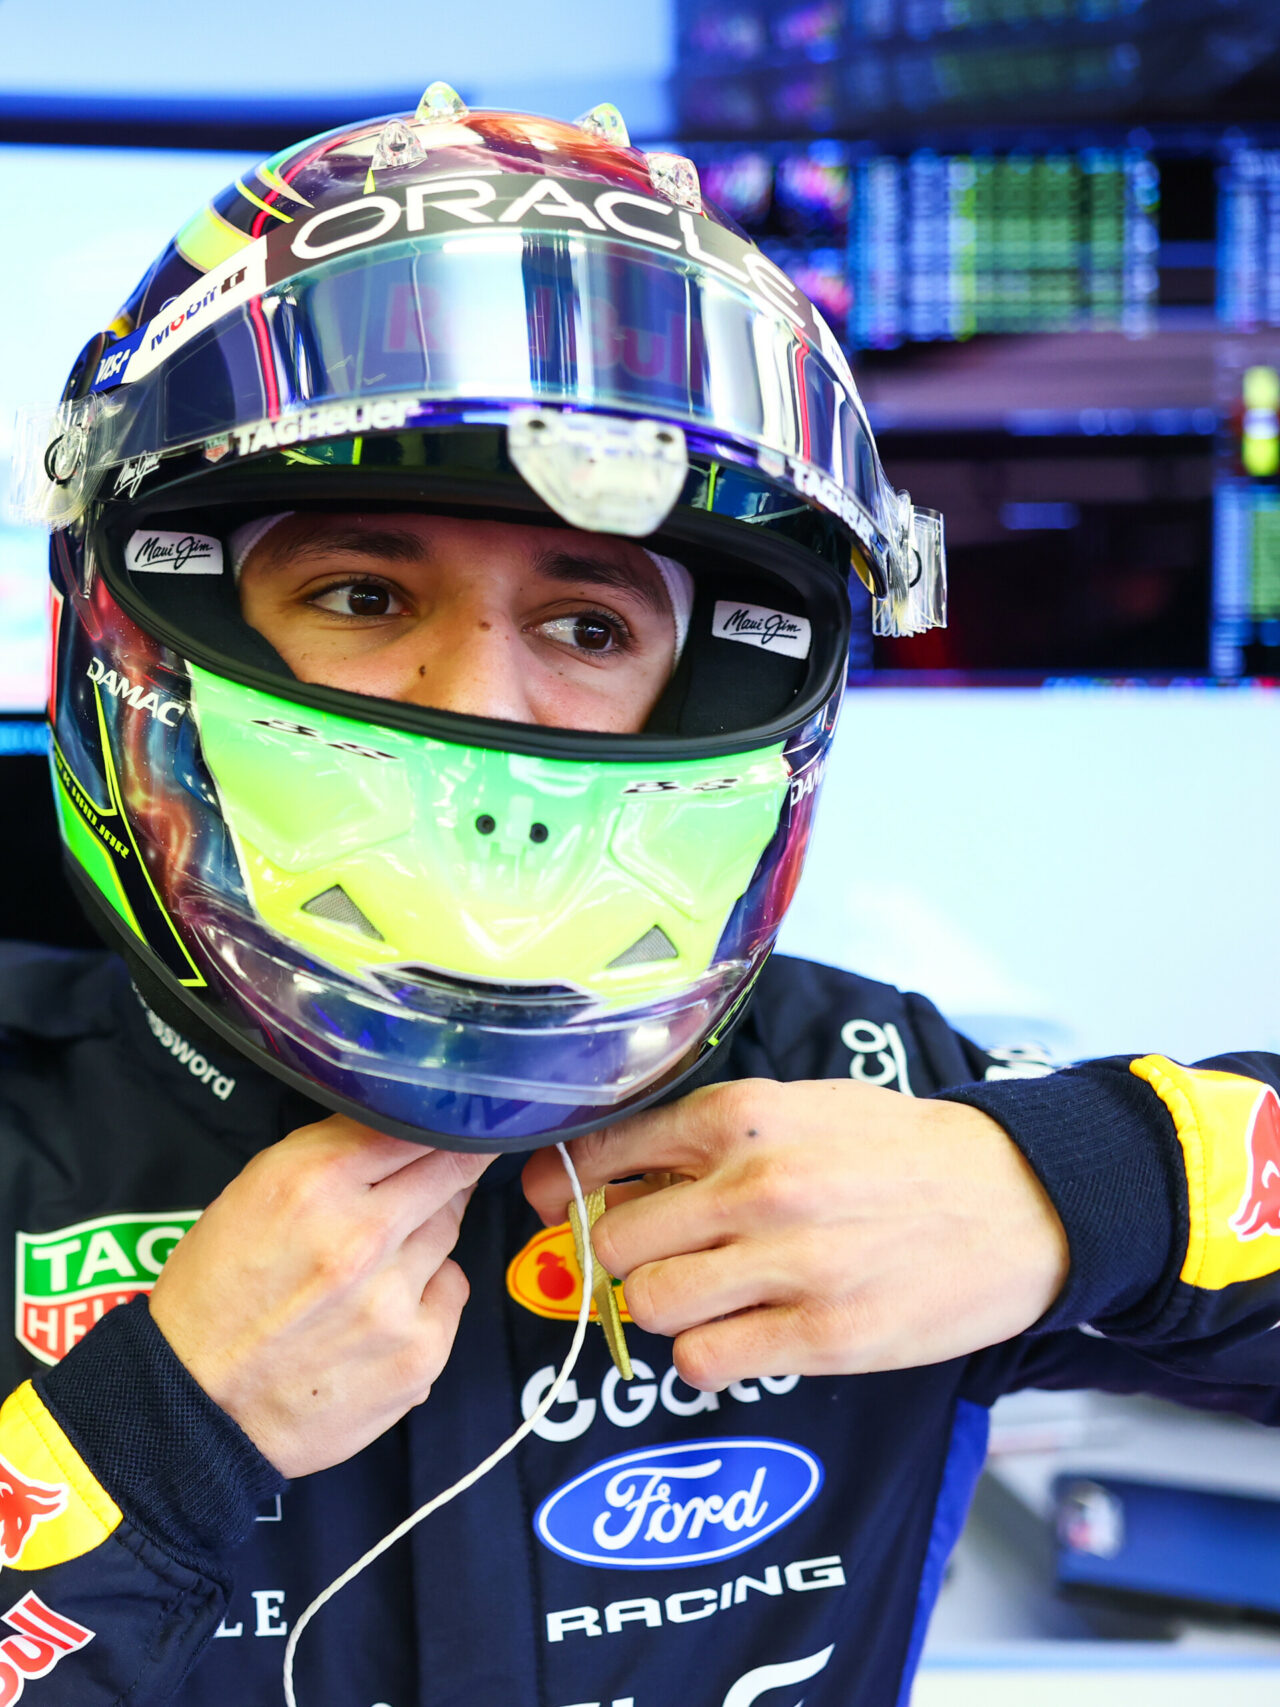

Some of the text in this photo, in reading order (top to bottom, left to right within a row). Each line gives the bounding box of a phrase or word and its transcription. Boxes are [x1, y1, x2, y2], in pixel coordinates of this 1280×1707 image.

[290, 178, 806, 328] ORACLE
[134, 536, 214, 570] Maui Jim
[723, 609, 801, 645] Maui Jim
[87, 657, 186, 727] DAMAC
[790, 758, 828, 807] DAM
[144, 1004, 236, 1101] ssword
[593, 1459, 769, 1551] Ford
[545, 1555, 847, 1643] RACING
